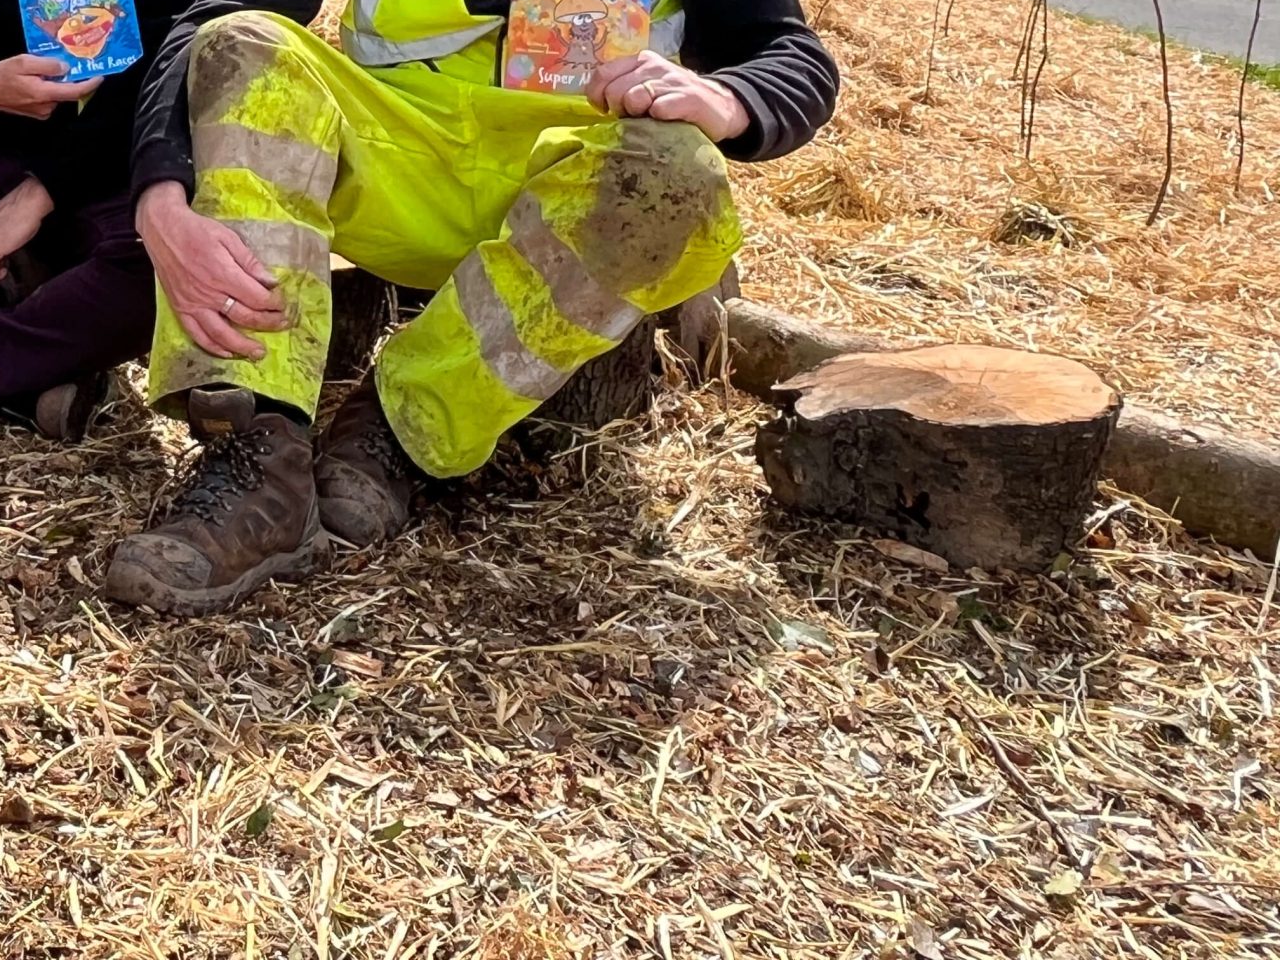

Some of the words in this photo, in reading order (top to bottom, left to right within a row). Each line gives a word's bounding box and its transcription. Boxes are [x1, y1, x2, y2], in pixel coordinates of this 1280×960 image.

[71, 61, 82, 74] at
[87, 58, 104, 71] the
[538, 67, 575, 90] Super
